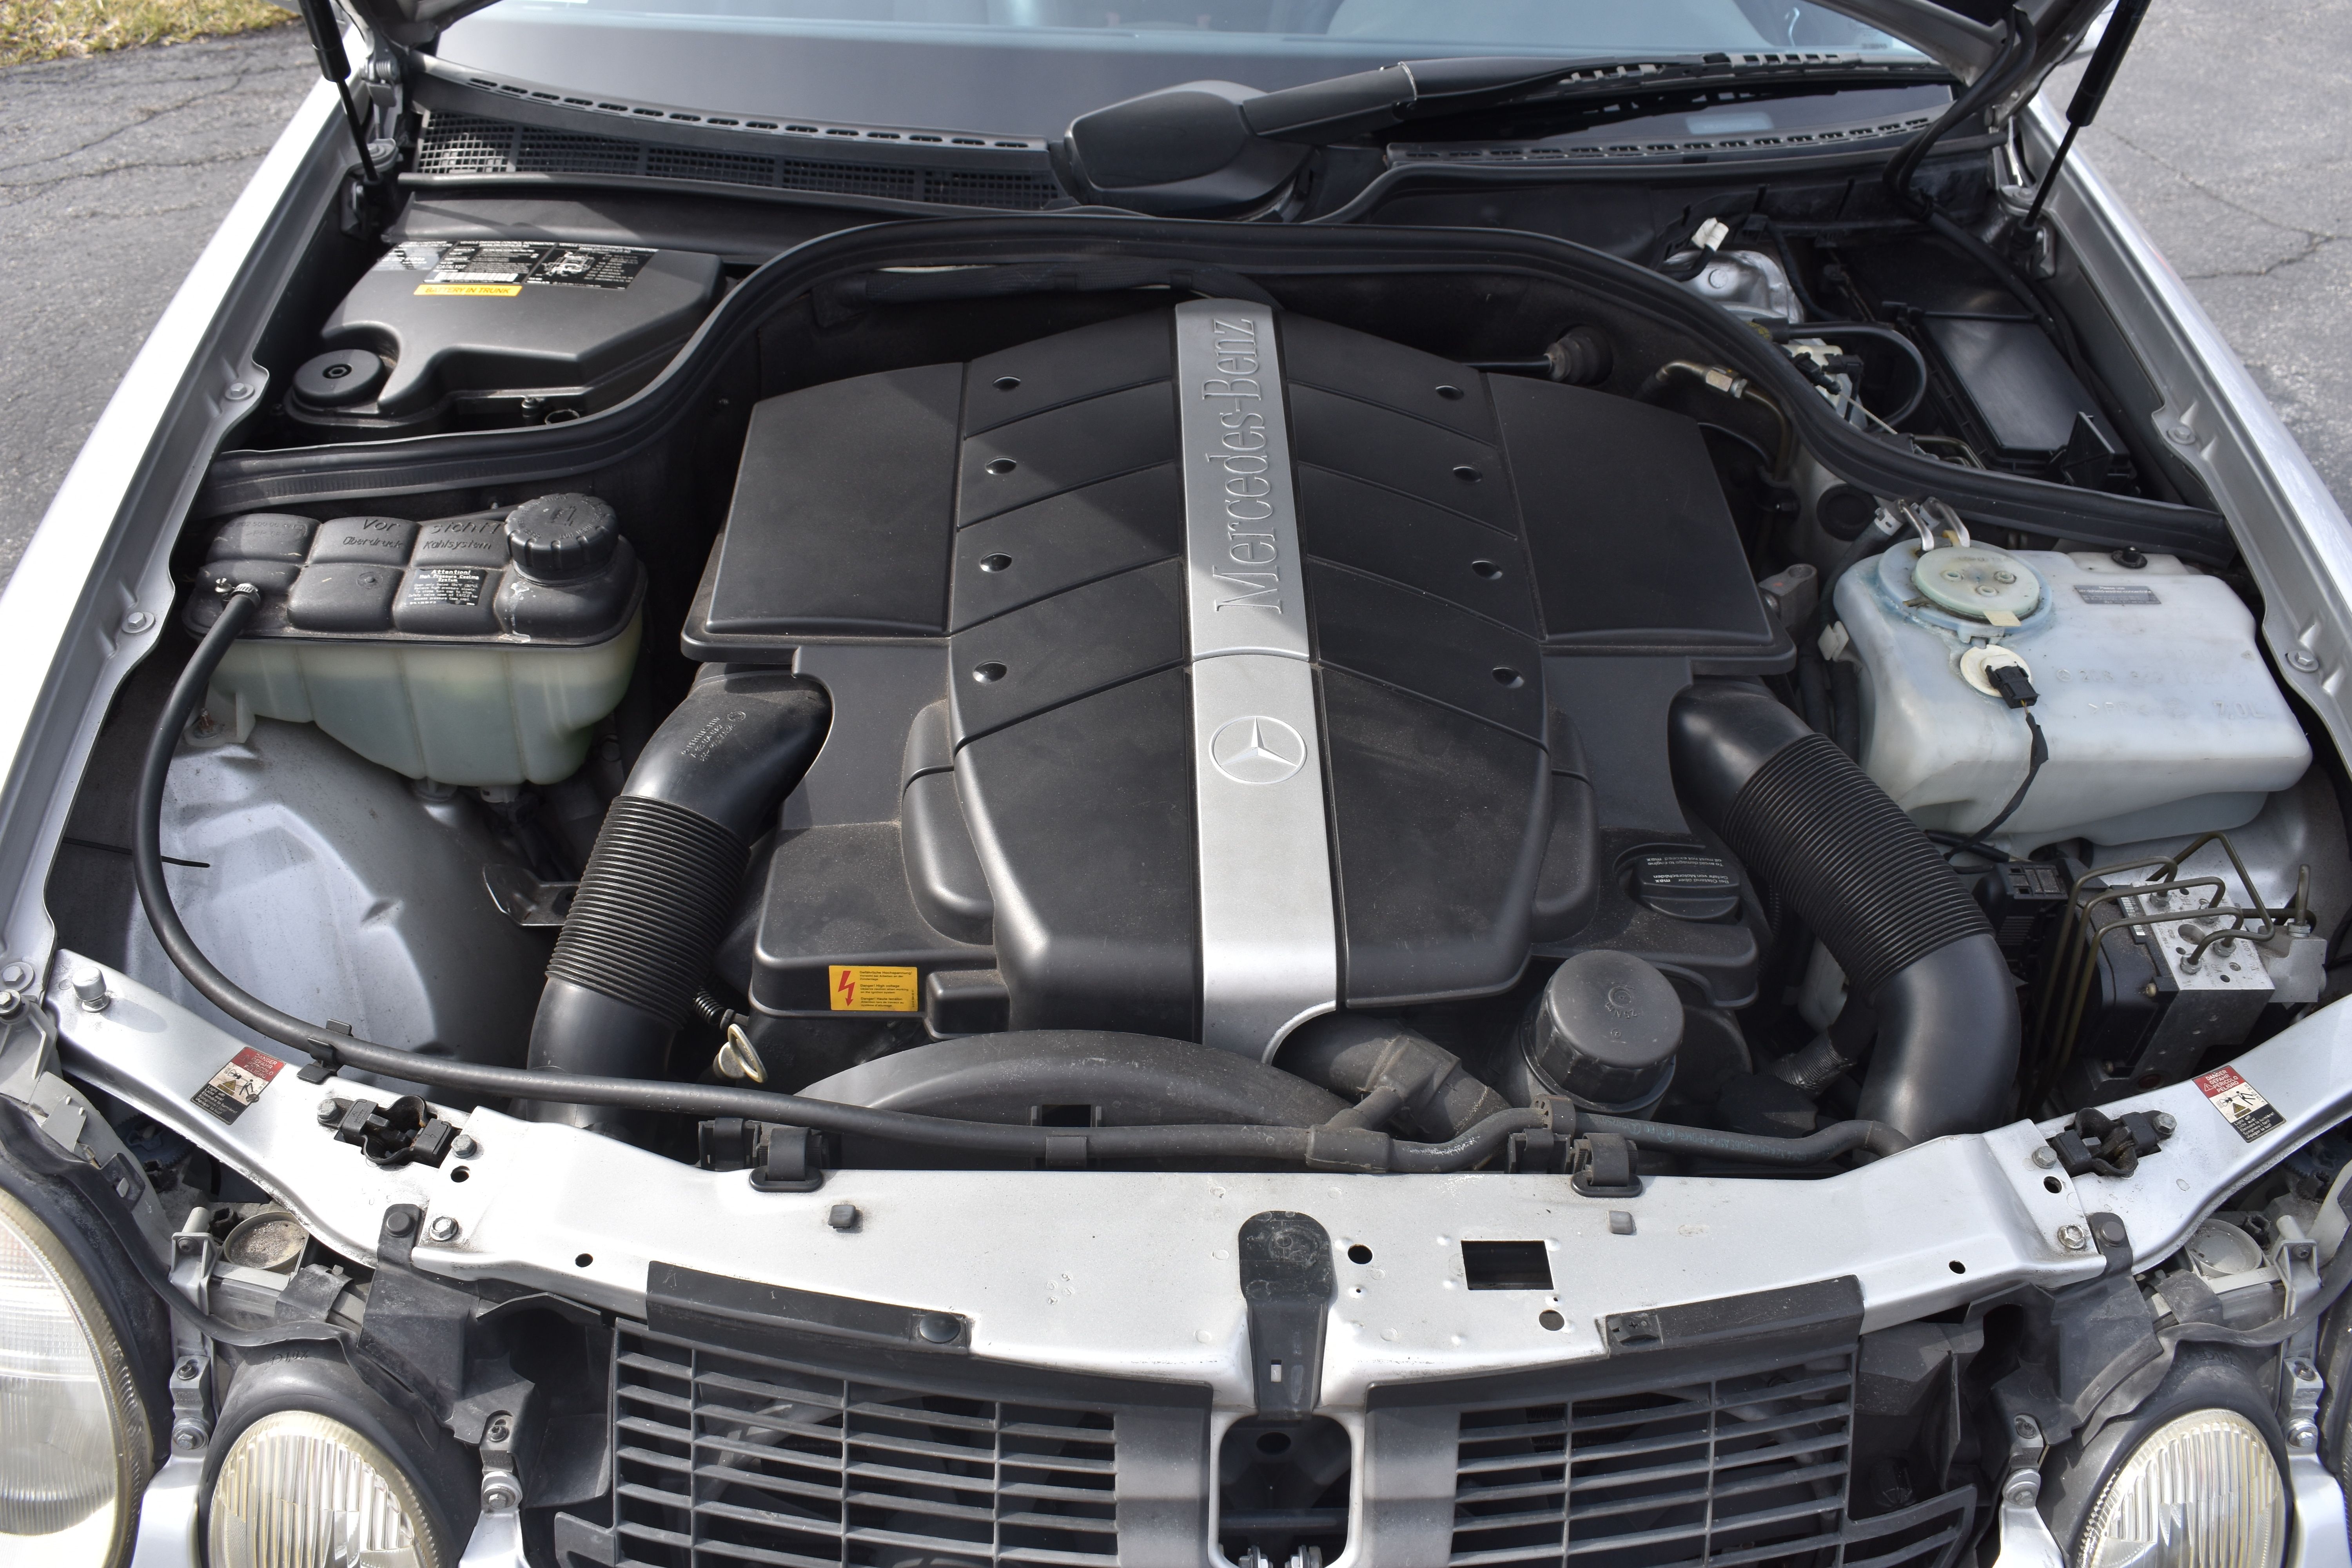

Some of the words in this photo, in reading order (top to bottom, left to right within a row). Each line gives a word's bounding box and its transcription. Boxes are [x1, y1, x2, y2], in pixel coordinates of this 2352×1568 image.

[1201, 318, 1282, 614] Mercedes-Benz
[363, 519, 401, 531] Vor
[430, 521, 501, 534] sicht!
[251, 1057, 273, 1069] GEFAHR
[255, 1053, 278, 1066] DANGER
[243, 1065, 267, 1078] PELIGRO
[248, 1062, 274, 1076] PERICOLO
[2205, 1070, 2227, 1081] DANGER
[2209, 1074, 2230, 1085] GEFAHR
[2213, 1076, 2238, 1089] PERICOLO
[2216, 1081, 2239, 1093] PELIGRO
[204, 1088, 214, 1096] Licht
[208, 1085, 218, 1094] Light
[2243, 1125, 2261, 1135] Spegnere
